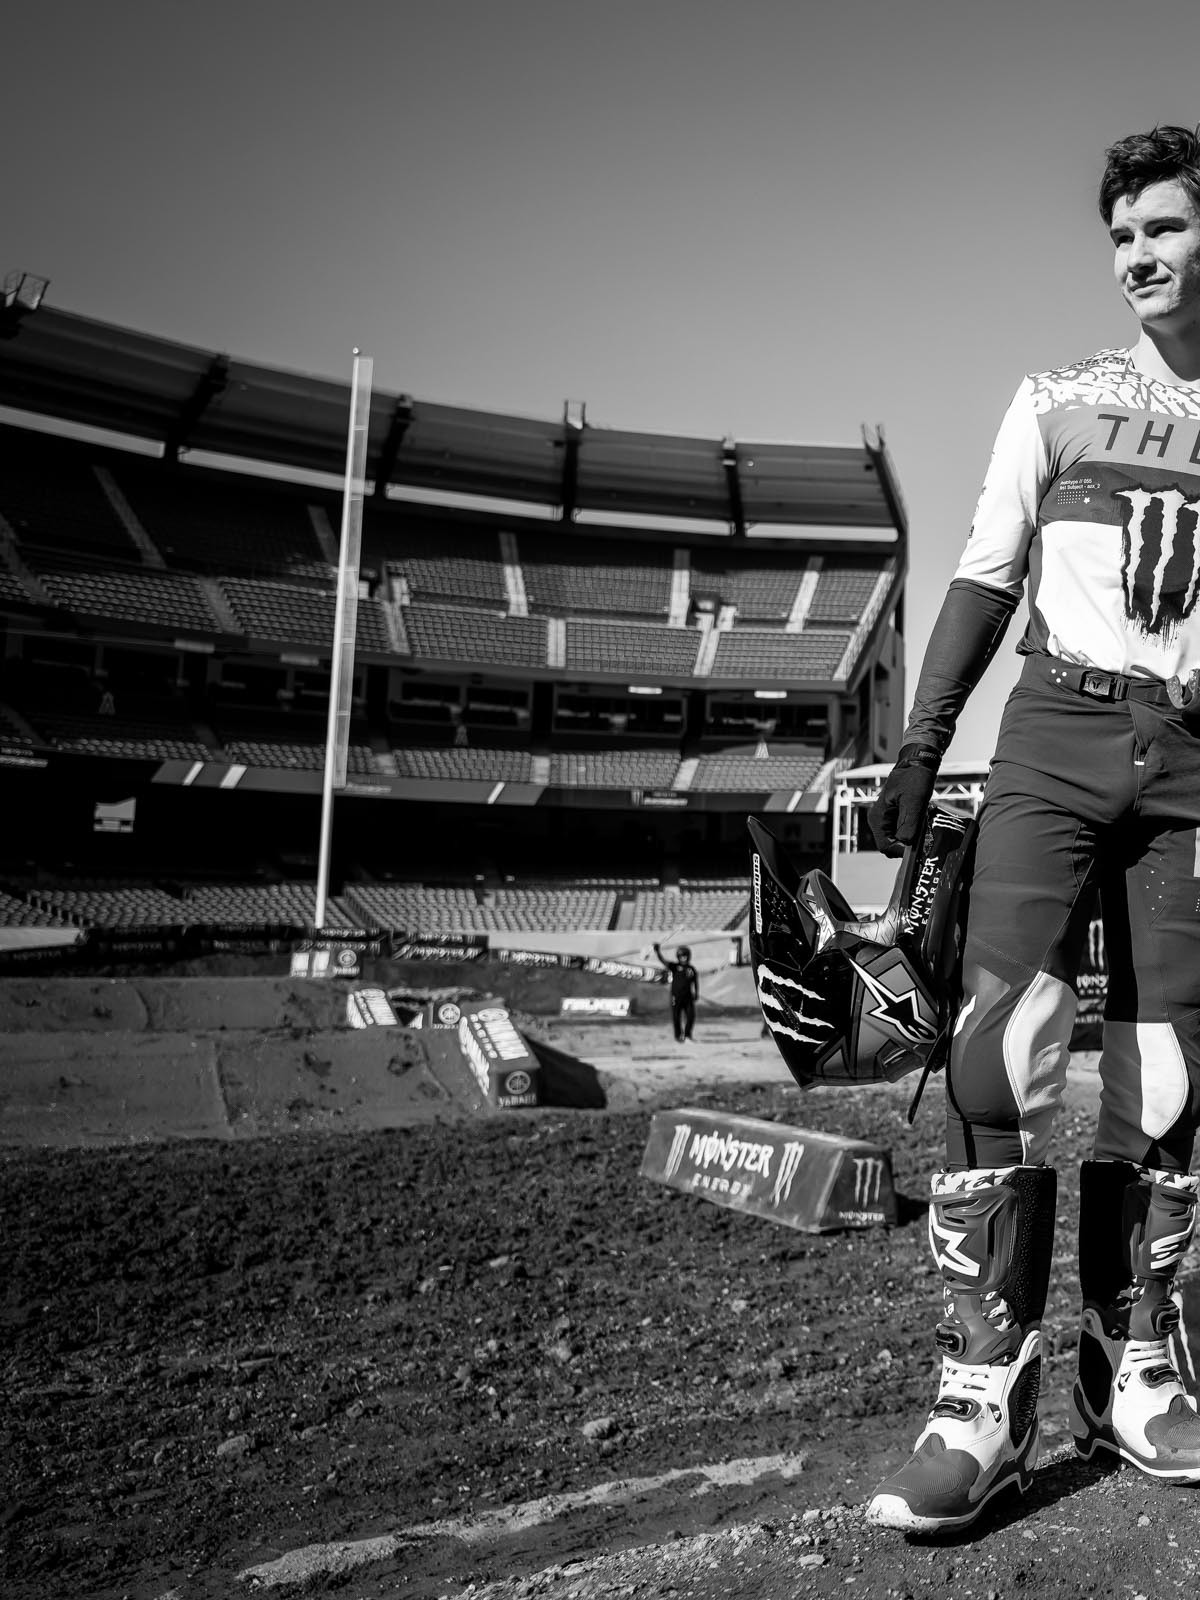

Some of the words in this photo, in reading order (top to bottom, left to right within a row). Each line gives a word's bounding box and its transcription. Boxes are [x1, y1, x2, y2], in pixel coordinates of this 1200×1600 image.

[904, 856, 939, 935] MONSTER
[921, 868, 942, 925] ENERGY
[689, 1130, 774, 1178] MONSTER
[691, 1173, 751, 1196] ENERGY
